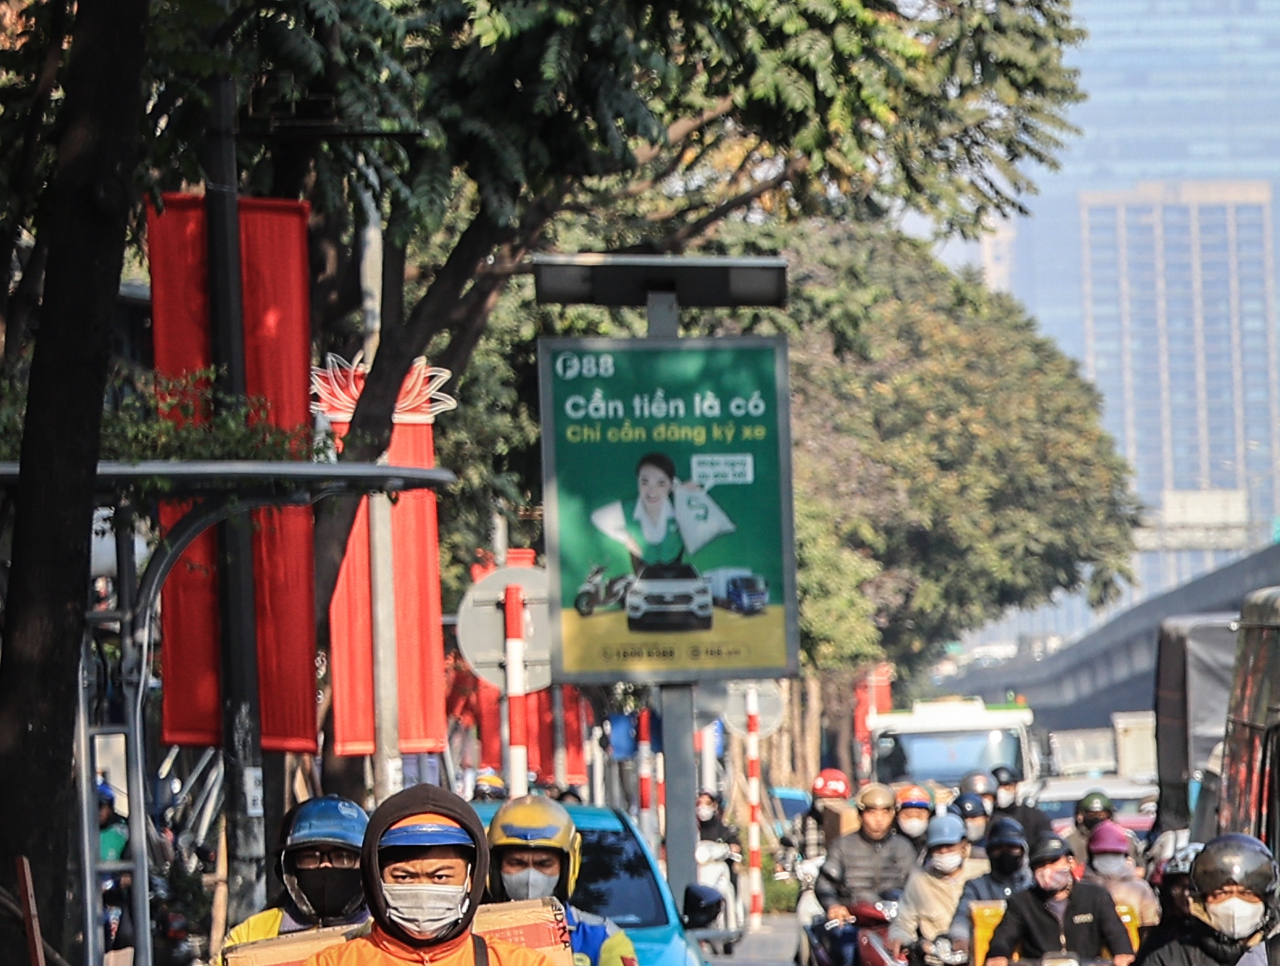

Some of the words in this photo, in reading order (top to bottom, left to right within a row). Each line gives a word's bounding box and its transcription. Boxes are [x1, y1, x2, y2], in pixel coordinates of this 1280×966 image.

[565, 387, 625, 420] Cần
[632, 387, 686, 419] tiền
[693, 390, 721, 418] là
[729, 389, 766, 417] có
[606, 418, 647, 443] cần
[653, 422, 707, 446] đăng
[712, 420, 736, 443] ký
[741, 424, 767, 441] xe
